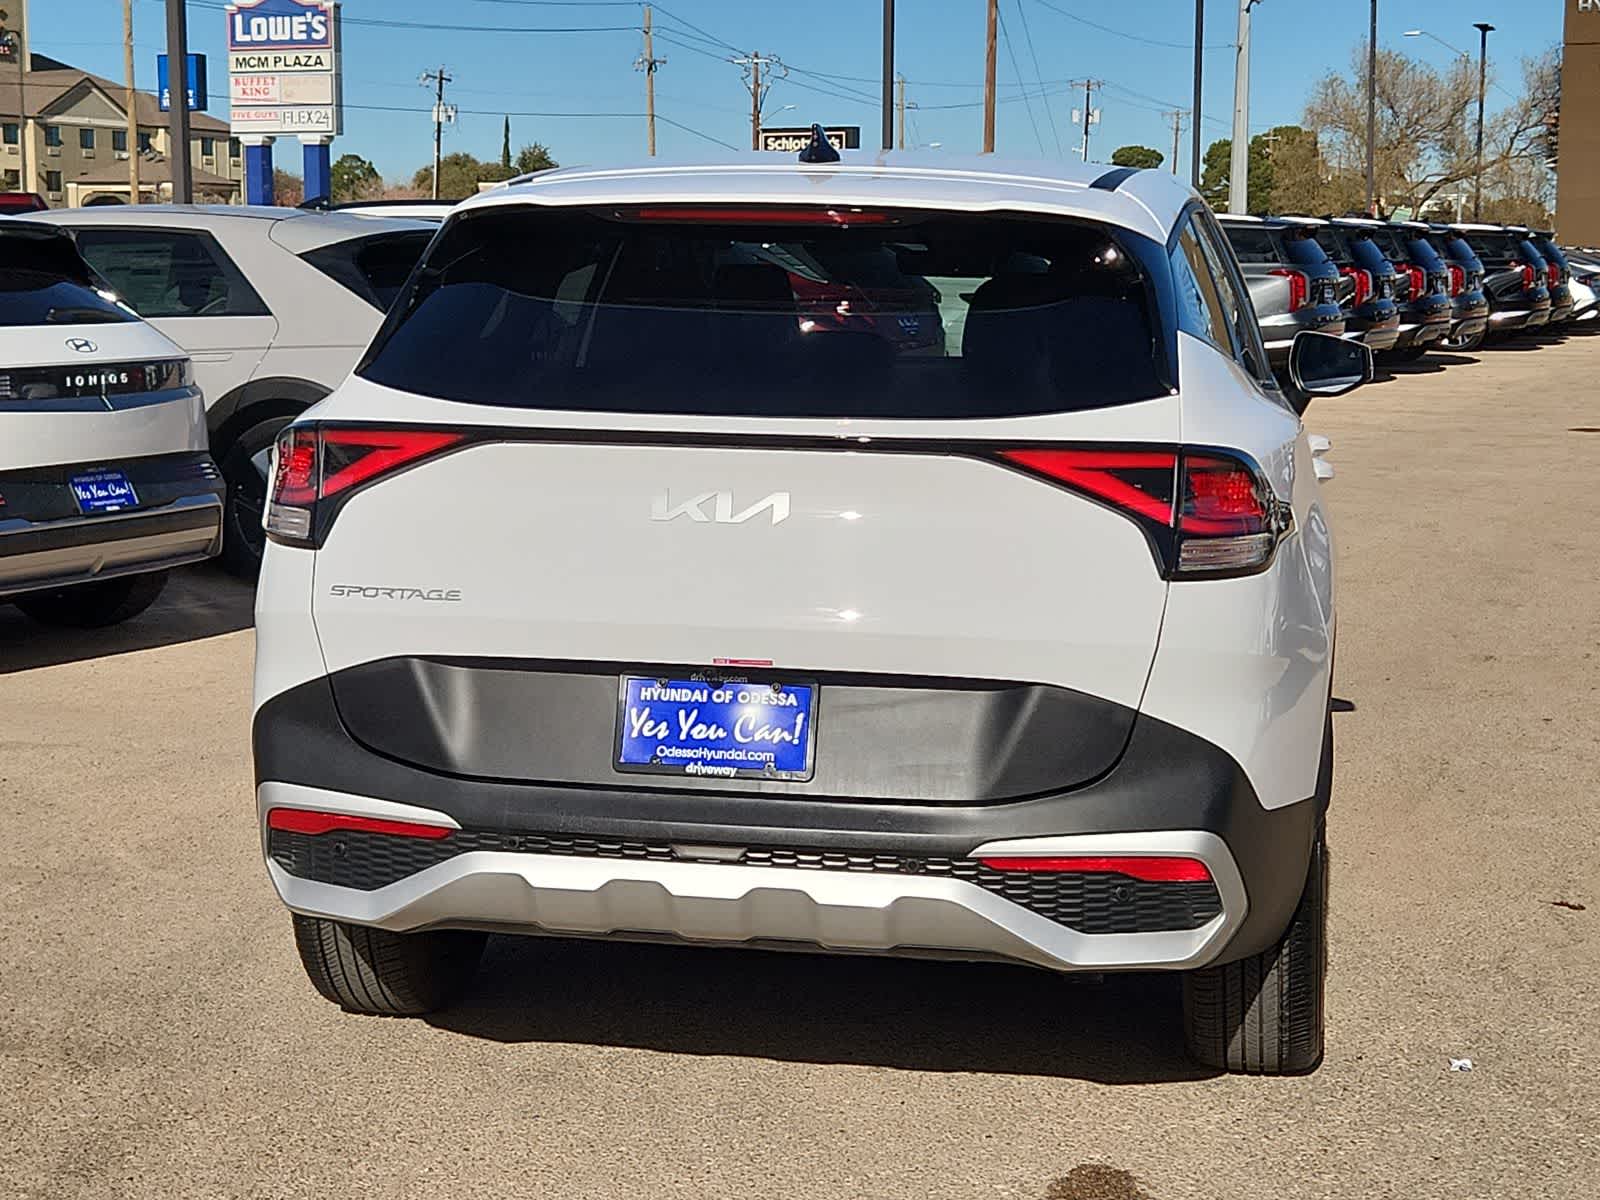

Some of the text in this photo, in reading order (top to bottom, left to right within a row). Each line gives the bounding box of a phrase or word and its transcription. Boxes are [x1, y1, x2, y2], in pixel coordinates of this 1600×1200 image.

[235, 11, 327, 42] LOWE'S
[235, 55, 324, 69] MCM PLAZA
[234, 76, 276, 87] BUFFET
[242, 87, 270, 97] KING
[232, 111, 253, 119] FIVE
[766, 136, 841, 152] Schlot's
[330, 584, 462, 601] SPORTAGE
[640, 687, 798, 707] HYUNDAI OF ODESSA
[630, 707, 805, 745] Yes You Can!
[656, 745, 775, 762] OdessaHyundai.com
[685, 762, 738, 778] driveway
